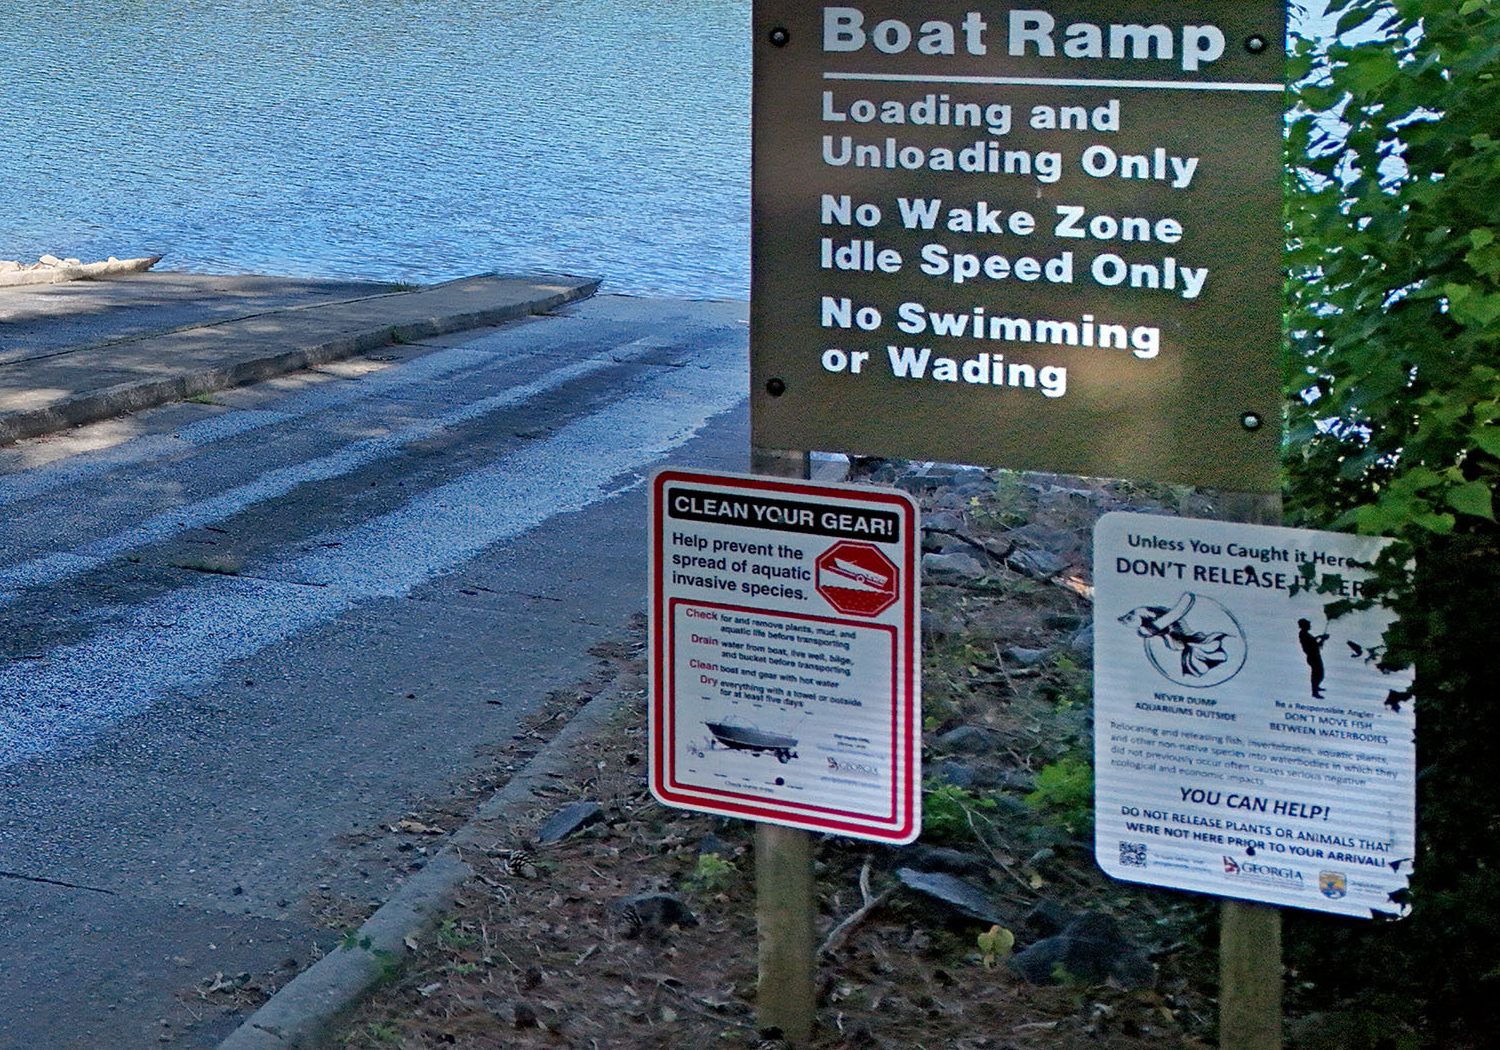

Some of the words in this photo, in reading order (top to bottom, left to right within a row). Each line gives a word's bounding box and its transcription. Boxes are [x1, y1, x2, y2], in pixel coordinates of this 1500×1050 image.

[822, 6, 987, 57] Boat
[1007, 9, 1226, 71] Ramp
[822, 90, 1012, 135] Loading
[1030, 99, 1120, 132] and
[822, 135, 1062, 184] Unloading
[1082, 145, 1199, 188] Only
[821, 194, 881, 228] No
[898, 196, 1035, 236] Wake
[1055, 205, 1183, 244] Zone
[821, 238, 903, 274] Idle
[920, 244, 1073, 284] Speed
[1091, 254, 1208, 299] Only
[821, 296, 881, 331] No
[898, 303, 1160, 359] Swimming
[821, 348, 868, 375] or
[887, 346, 1067, 398] Wading
[674, 496, 748, 519] CLEAN
[753, 505, 814, 526] YOUR
[821, 513, 893, 535] GEAR!
[672, 532, 708, 551] Help
[713, 539, 773, 557] prevent
[778, 546, 803, 559] the
[1128, 535, 1184, 551] Unless
[1190, 540, 1221, 554] You
[1227, 543, 1288, 563] Caught
[1295, 549, 1307, 562] it
[672, 553, 726, 570] spread
[731, 560, 747, 573] of
[751, 565, 811, 582] aquatic
[1117, 558, 1187, 579] DON'T
[1194, 565, 1287, 590] RELEASE
[672, 571, 737, 590] invasive
[741, 582, 808, 600] species.
[686, 608, 718, 620] Check
[721, 614, 732, 622] for
[734, 617, 750, 625] and
[752, 620, 783, 629] remove
[692, 634, 718, 645] Drain
[746, 643, 765, 652] from
[768, 632, 794, 641] before
[690, 659, 718, 671] Clean
[720, 665, 738, 674] boat
[759, 671, 777, 679] gear
[779, 674, 797, 682] with
[816, 680, 839, 688] water
[722, 651, 737, 659] and
[739, 653, 766, 663] bucket
[769, 658, 796, 667] before
[700, 675, 718, 687] Dry
[720, 681, 764, 694] everything
[766, 687, 784, 695] with
[794, 691, 816, 700] towel
[829, 697, 862, 707] outside
[744, 692, 763, 701] least
[766, 695, 781, 704] five
[783, 698, 804, 708] days
[1154, 692, 1184, 703] NEVER
[1187, 696, 1217, 707] DUMP
[1135, 702, 1194, 716] AQUARIUMS
[1196, 710, 1236, 721] OUTSIDE
[1285, 712, 1316, 723] DON'T
[1319, 716, 1348, 727] MOVE
[1352, 720, 1373, 730] FISH
[1295, 702, 1344, 715] Responsible
[1348, 710, 1374, 719] Angler
[1110, 721, 1159, 736] Relocating
[1181, 731, 1223, 744] releasing
[1318, 750, 1353, 761] aquatic
[1269, 722, 1317, 735] BETWEEN
[1319, 729, 1388, 744] WATERBODIES
[1110, 734, 1128, 742] and
[1130, 736, 1156, 746] other
[1270, 756, 1330, 769] waterbodies
[1345, 765, 1373, 775] which
[1375, 768, 1398, 779] they
[1110, 746, 1125, 754] did
[1146, 750, 1194, 764] previously
[1196, 758, 1222, 767] occur
[1224, 761, 1250, 770] often
[1253, 767, 1284, 776] causes
[1287, 770, 1321, 780] serious
[1325, 774, 1366, 785] negative
[1159, 765, 1176, 773] and
[1178, 769, 1224, 780] economic
[1180, 787, 1221, 805] YOU
[1226, 794, 1268, 812] CAN
[1274, 800, 1330, 820] HELP!
[1122, 806, 1139, 816] DO
[1143, 810, 1168, 820] NOT
[1172, 814, 1222, 828] RELEASE
[1225, 821, 1272, 836] PLANTS
[1276, 828, 1293, 838] OR
[1298, 831, 1355, 848] ANIMALS
[1359, 839, 1392, 852] THAT
[1126, 822, 1160, 835] WERE
[1164, 828, 1190, 838] NOT
[1193, 832, 1224, 844] HERE
[1228, 836, 1265, 850] PRIOR
[1268, 842, 1285, 852] TO
[1289, 846, 1324, 858] YOUR
[1328, 851, 1386, 867] ARRIVAL!
[1241, 862, 1303, 880] GEORGIA
